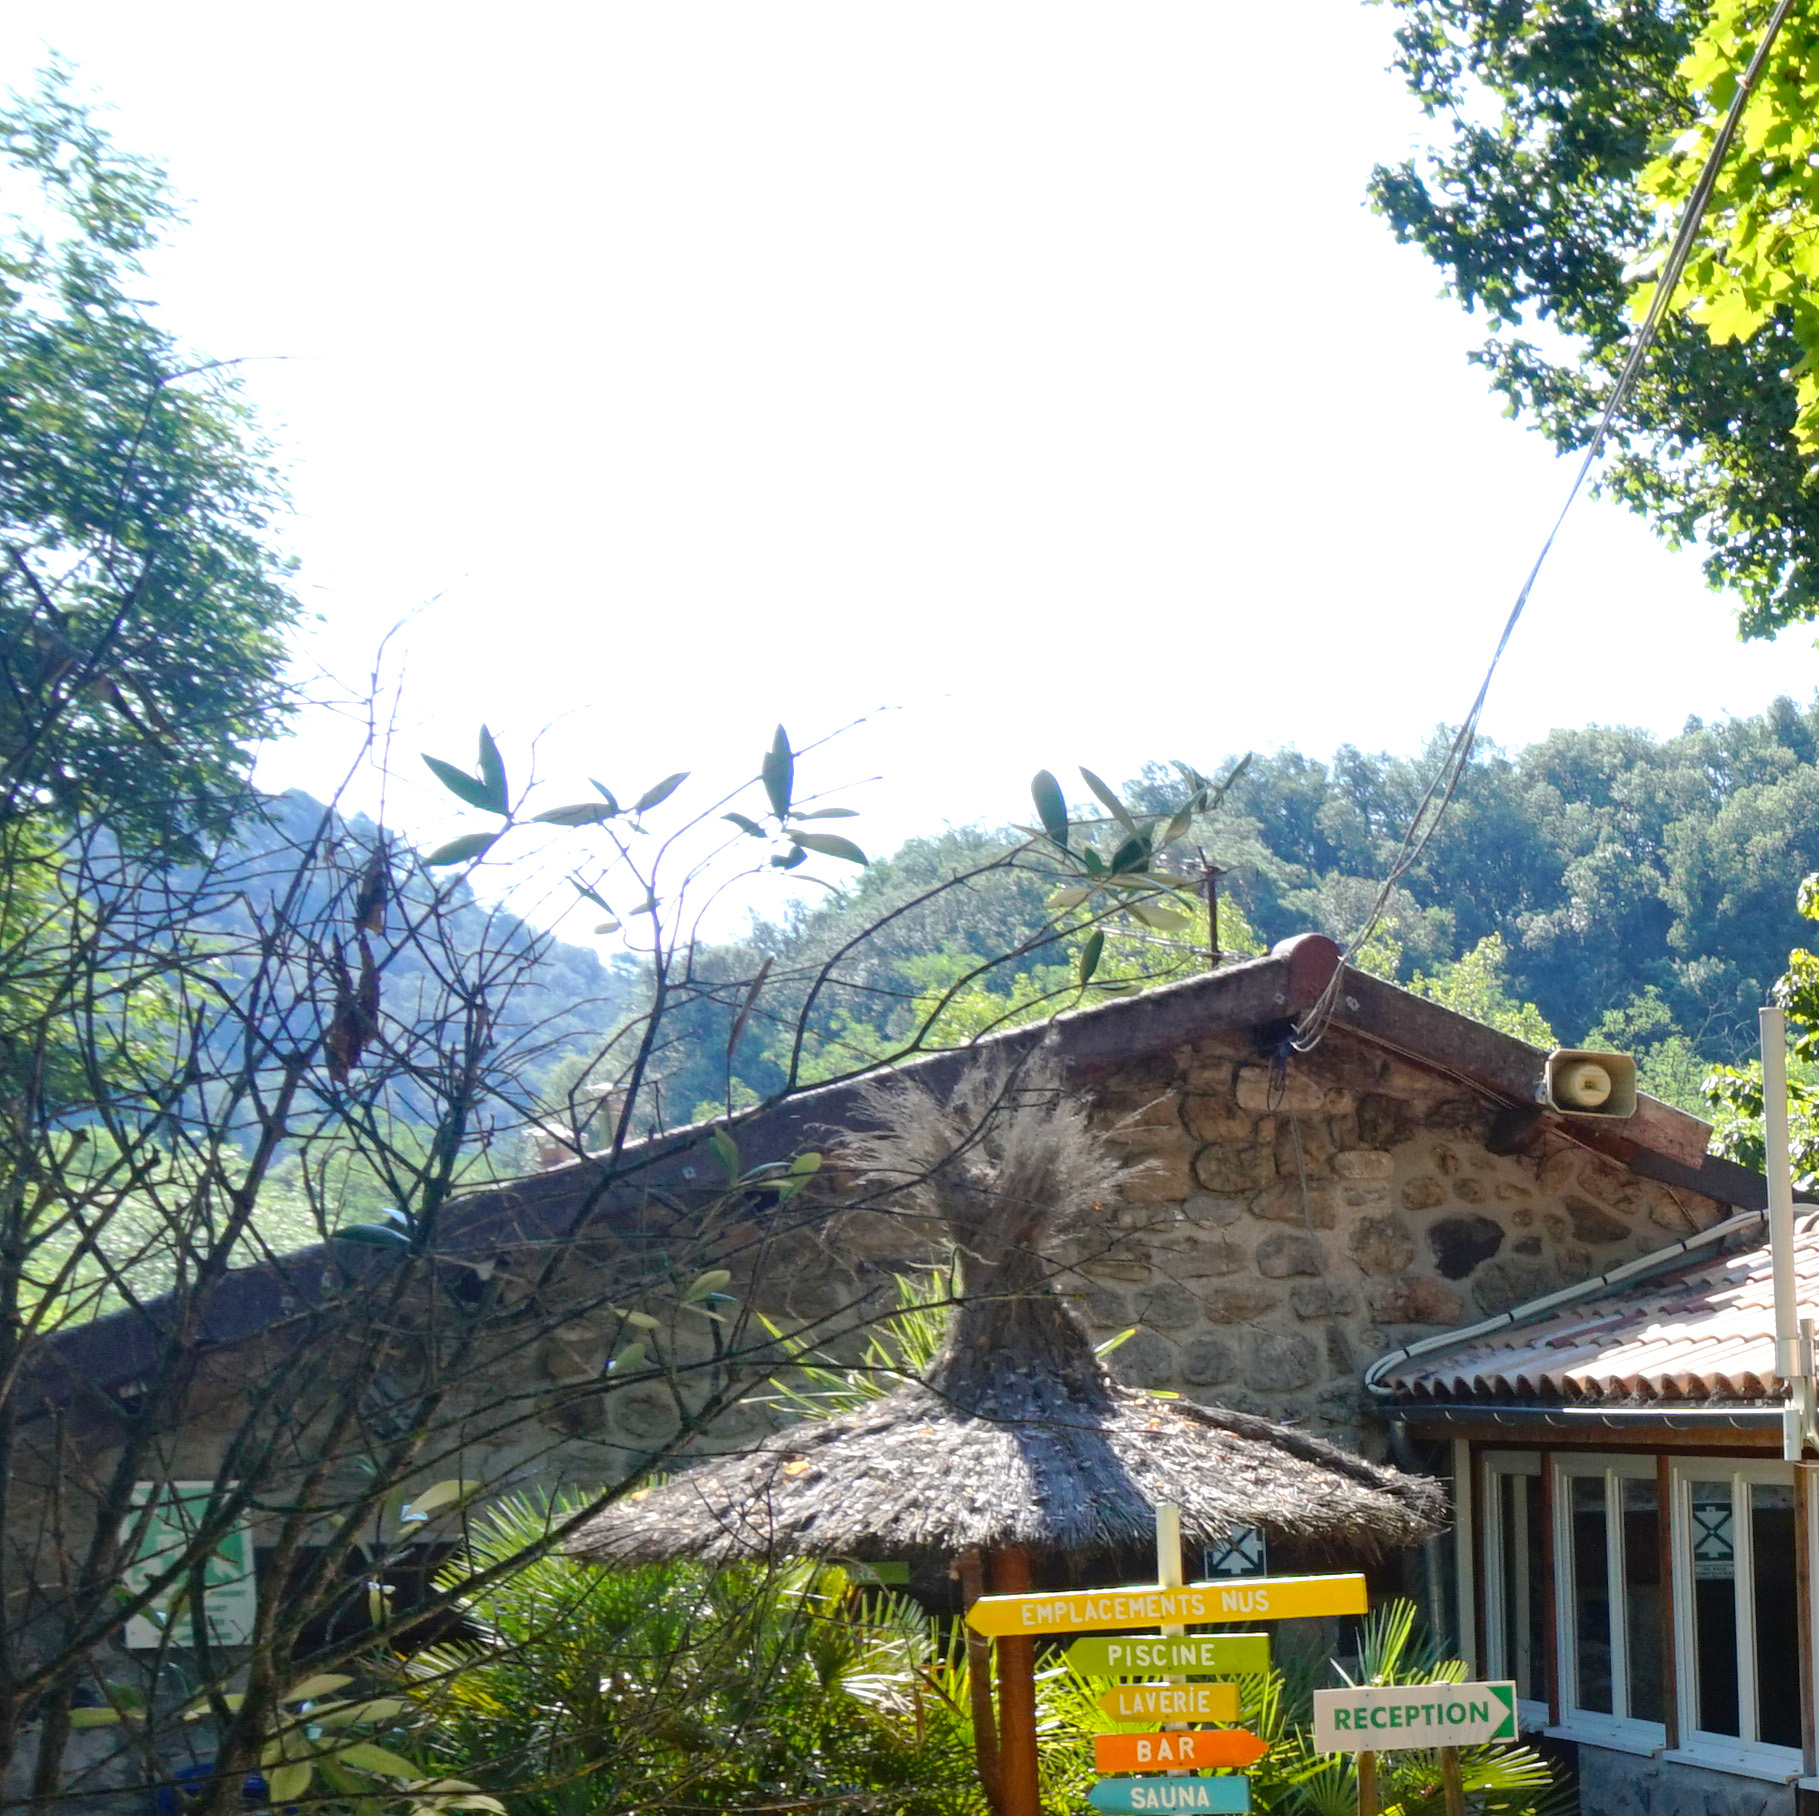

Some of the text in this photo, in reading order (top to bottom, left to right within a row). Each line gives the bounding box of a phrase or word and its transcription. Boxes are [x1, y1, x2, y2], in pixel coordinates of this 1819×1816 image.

[1021, 1589, 1270, 1627] EMPLACEMENTS NUS
[1107, 1643, 1216, 1668] PISCINE
[1333, 1700, 1490, 1732] RECEPTION
[1136, 1736, 1196, 1763] BAR
[1130, 1785, 1211, 1810] SAUNA
